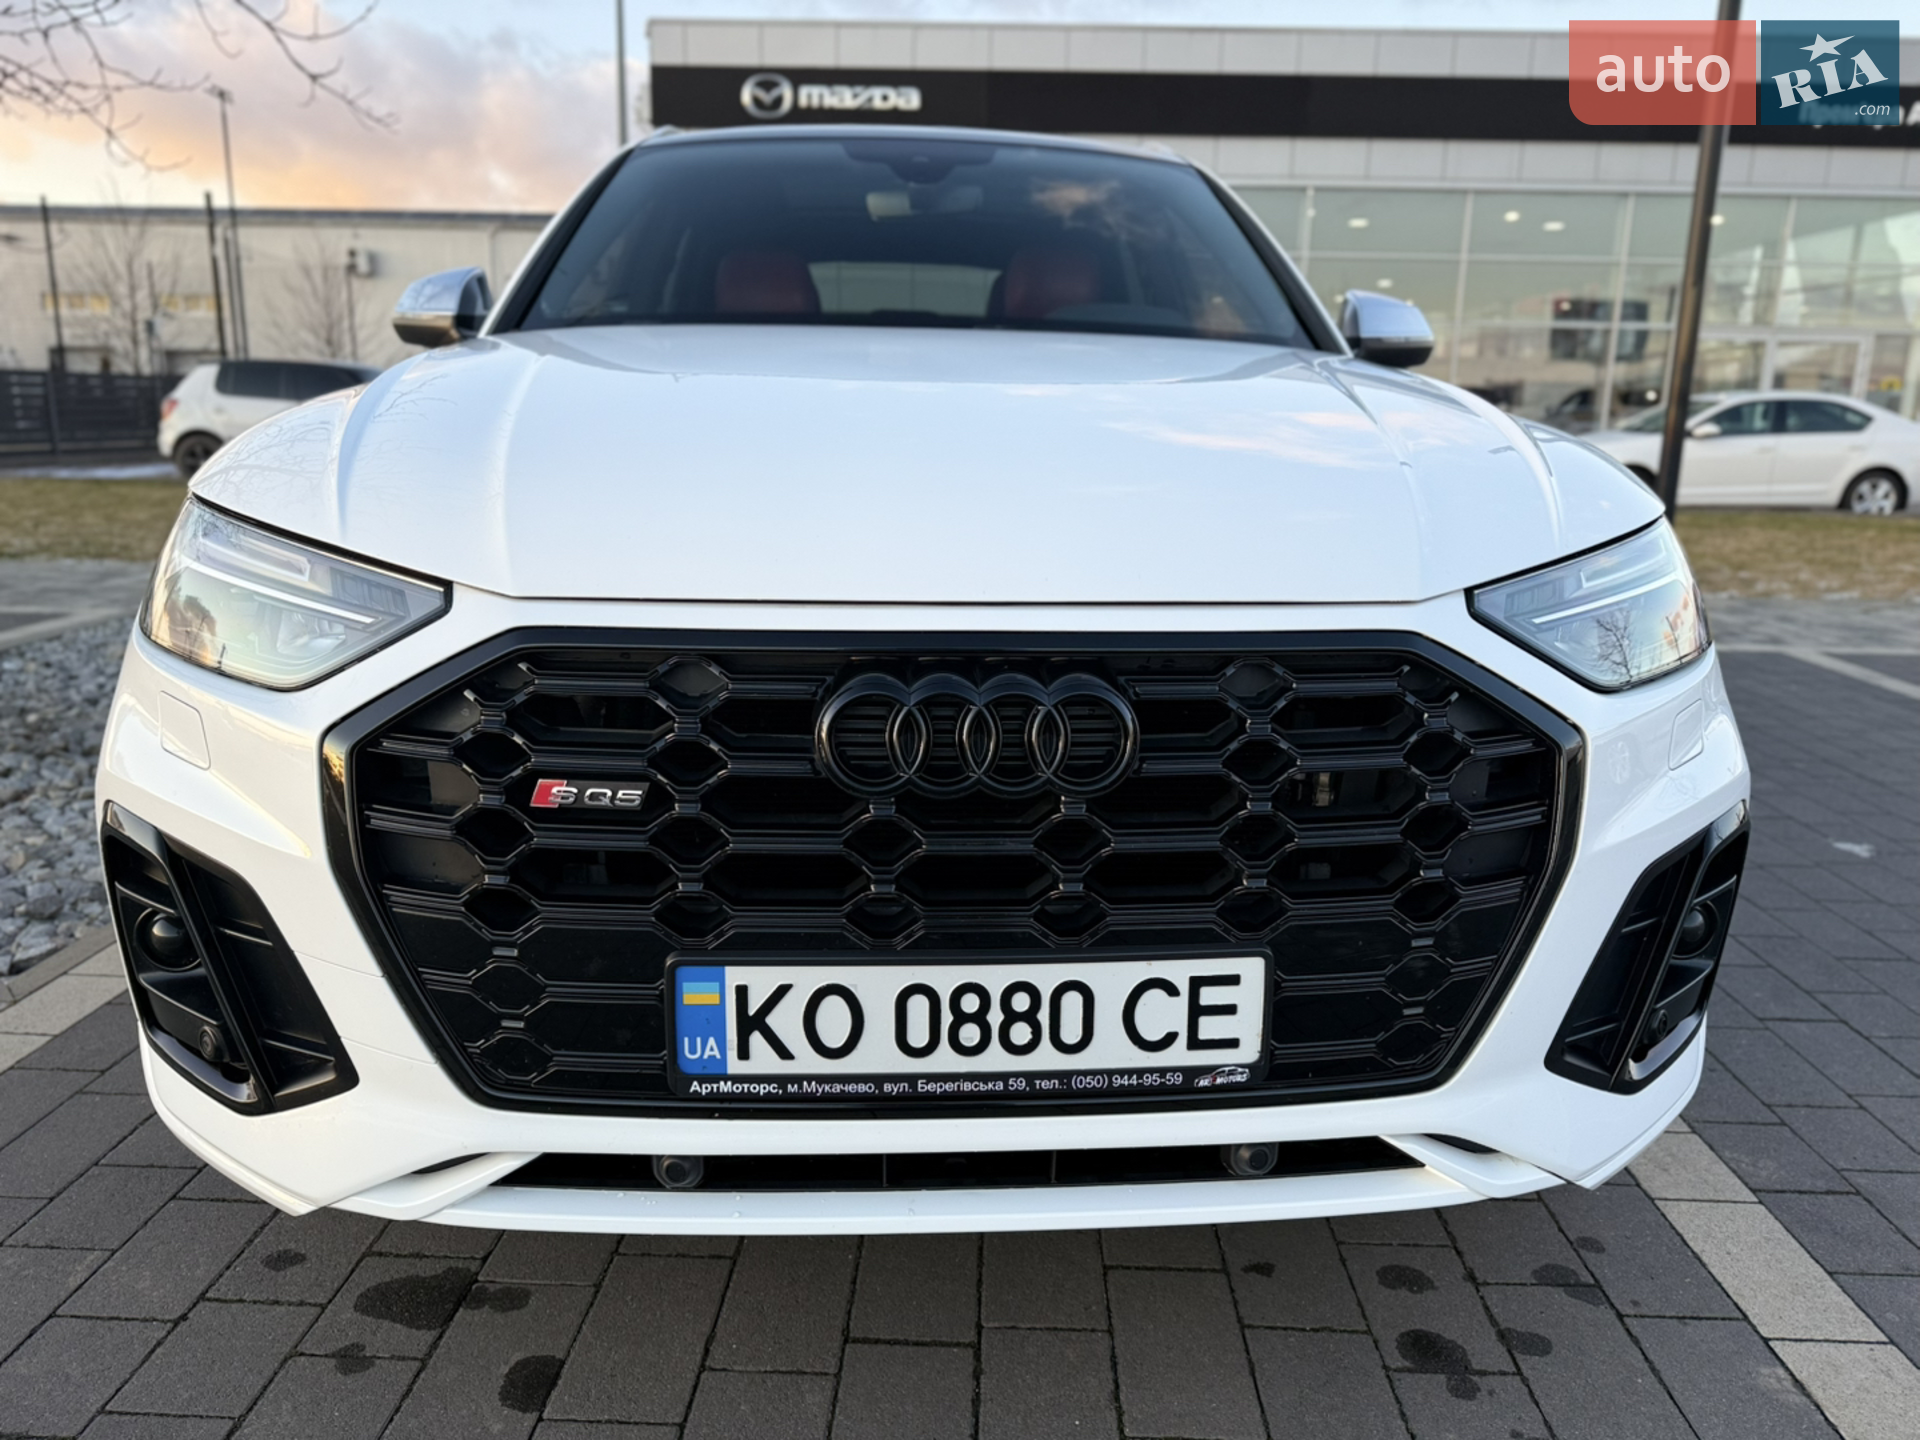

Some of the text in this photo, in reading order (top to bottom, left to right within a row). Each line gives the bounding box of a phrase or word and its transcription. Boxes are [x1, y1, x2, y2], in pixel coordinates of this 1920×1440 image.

[548, 786, 643, 807] SQ5
[735, 974, 1241, 1061] KO 0880 CE
[684, 1036, 722, 1060] UA
[689, 1080, 783, 1096] АртМоторс,
[883, 1082, 912, 1096] вул.
[917, 1078, 1004, 1094] Берегівська
[1008, 1077, 1031, 1091] 59,
[1034, 1078, 1067, 1090] тел.:
[1071, 1075, 1109, 1089] (050)
[1111, 1072, 1183, 1087] 944-95-59
